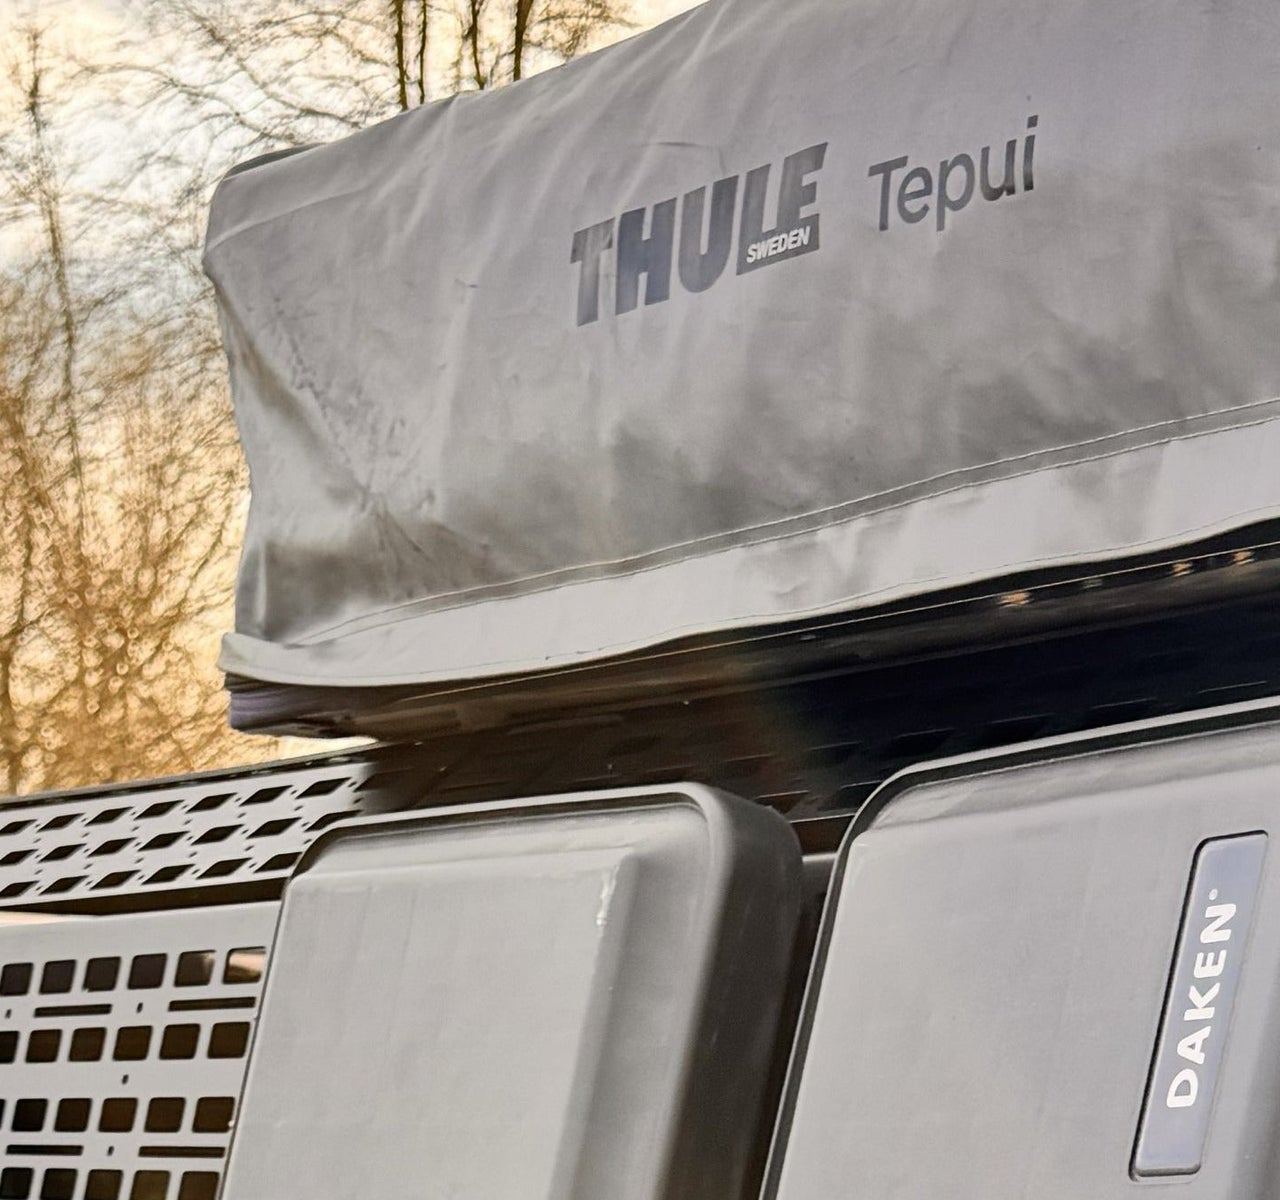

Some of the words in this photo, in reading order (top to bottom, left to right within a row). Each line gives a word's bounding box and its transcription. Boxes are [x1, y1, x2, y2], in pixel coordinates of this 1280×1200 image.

[569, 142, 829, 327] THULE
[867, 114, 1039, 232] Tepui
[746, 225, 810, 264] SWEDEN
[1166, 903, 1236, 1108] DAKEN
